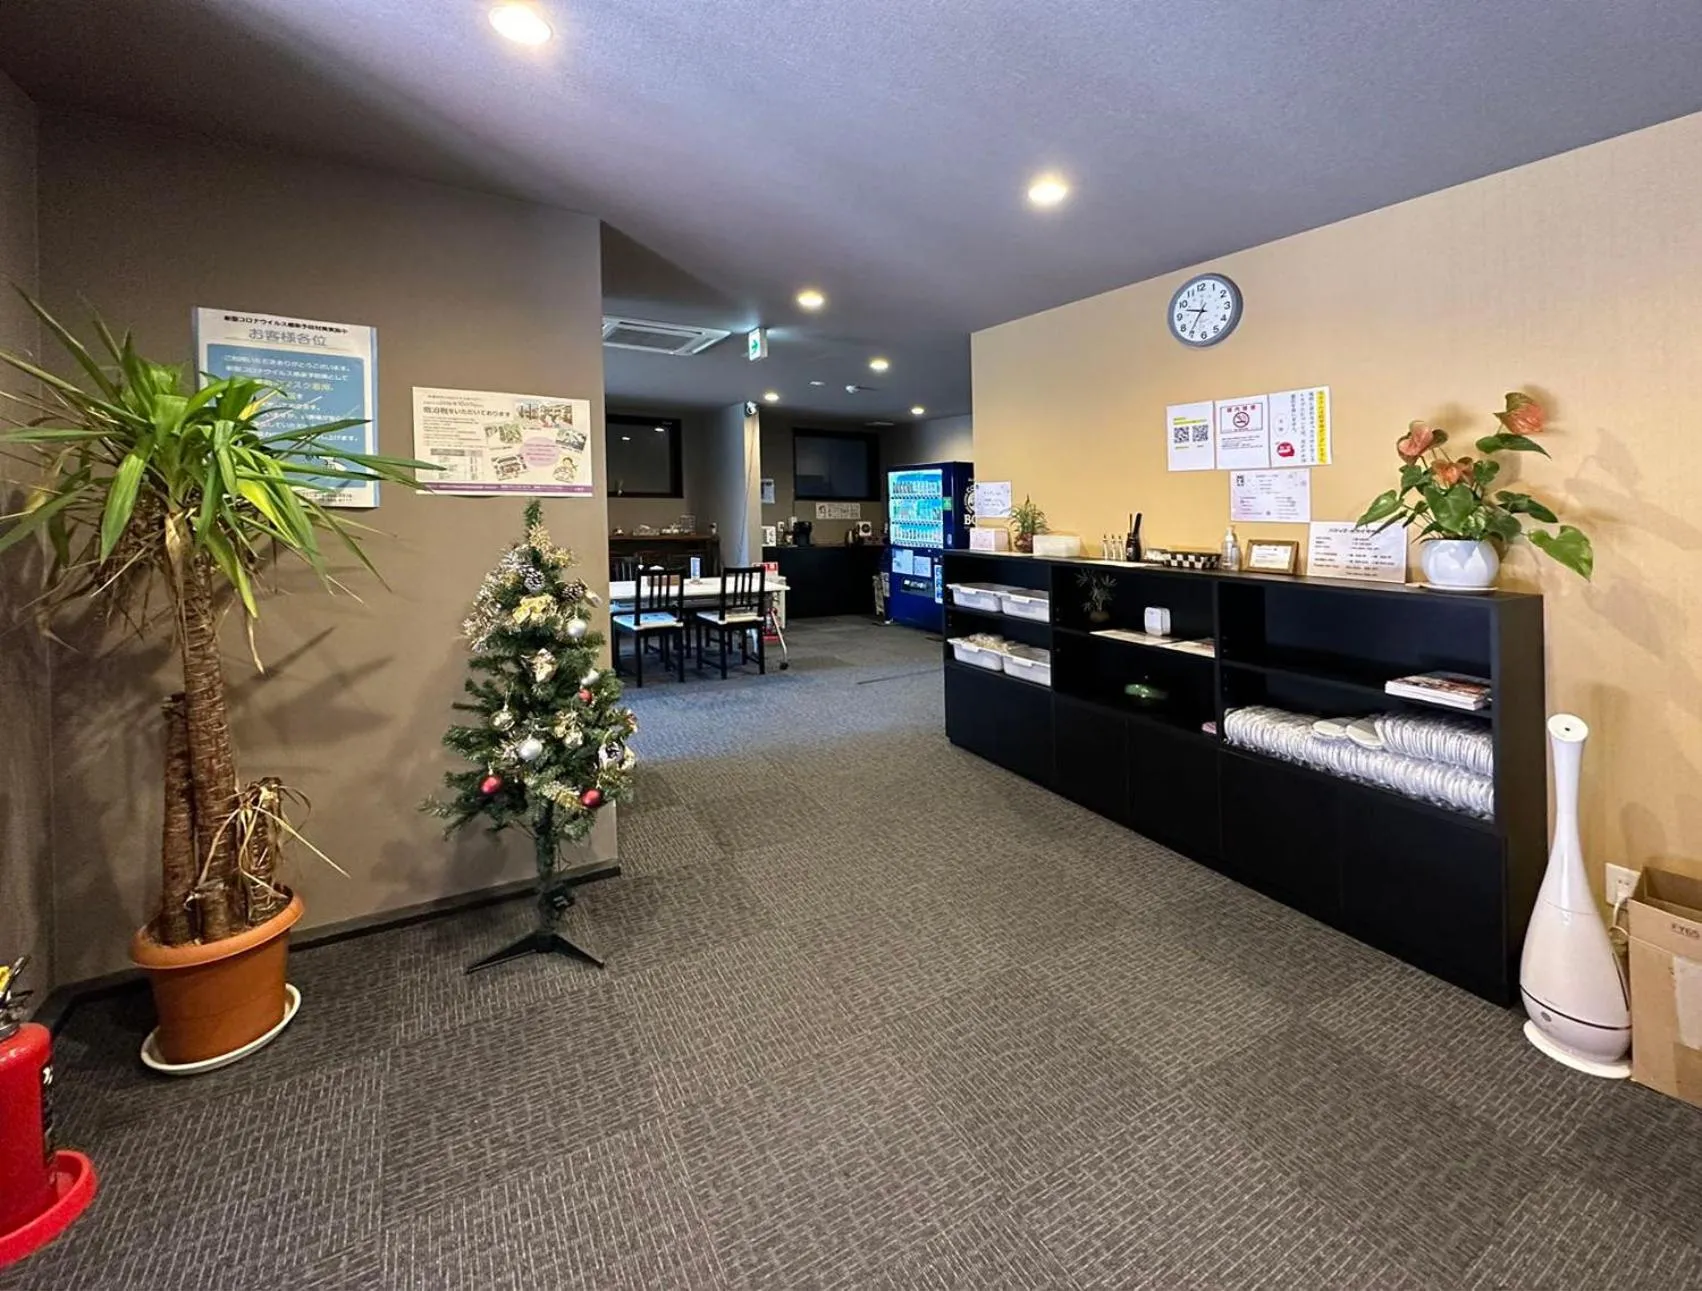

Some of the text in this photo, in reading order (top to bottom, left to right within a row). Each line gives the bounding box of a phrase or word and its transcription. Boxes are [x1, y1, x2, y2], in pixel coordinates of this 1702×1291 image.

[1196, 282, 1206, 292] 12
[1212, 283, 1216, 291] 1
[1187, 289, 1195, 298] 11
[1219, 289, 1227, 298] 2
[1179, 300, 1188, 309] 10
[1223, 301, 1231, 310] 3
[1176, 313, 1183, 321] 9
[1180, 324, 1187, 332] 8
[1212, 325, 1219, 333] 5
[249, 327, 328, 346] お客様各位
[1200, 331, 1207, 339] 6
